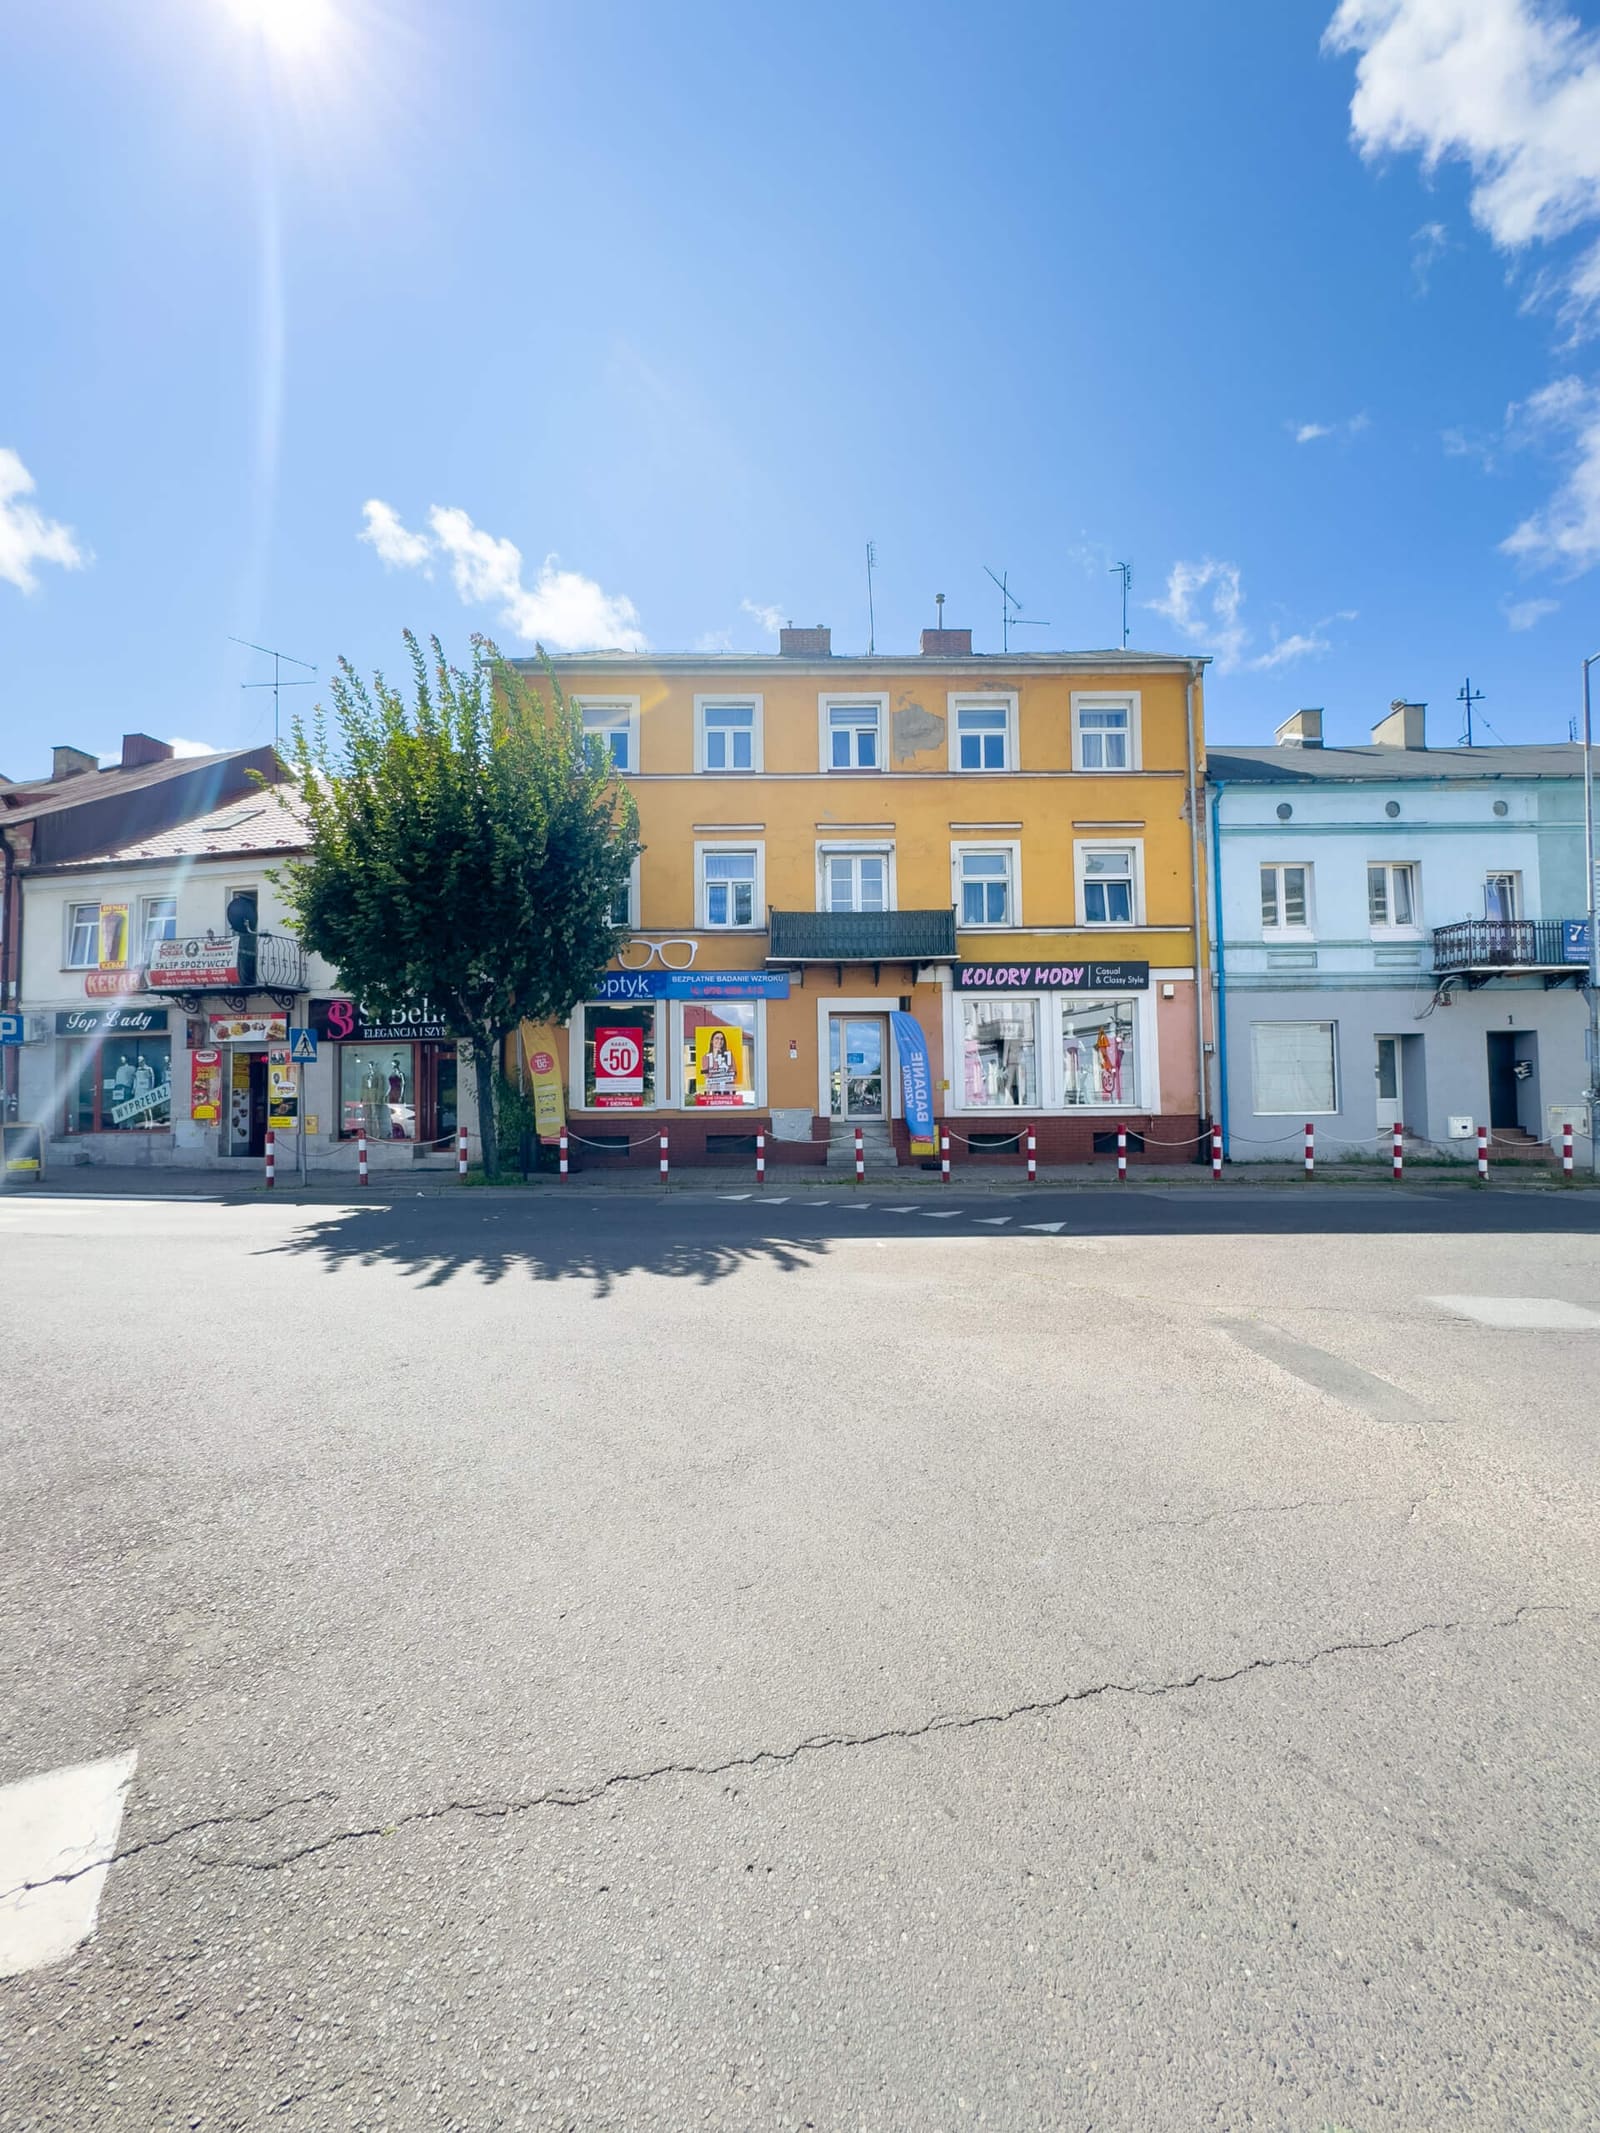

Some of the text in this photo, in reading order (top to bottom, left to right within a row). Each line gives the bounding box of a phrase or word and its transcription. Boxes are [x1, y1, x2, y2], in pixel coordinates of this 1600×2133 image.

[962, 966, 1085, 986] KOLORY MODY
[1095, 967, 1121, 976] Casual
[672, 975, 784, 983] BEZPŁATNE BADANIE WZROKU
[1095, 976, 1145, 985] & Classy Style
[594, 975, 649, 998] optyk
[66, 1009, 153, 1032] Top Lady
[1507, 1014, 1513, 1025] 1
[0, 1018, 17, 1035] P
[363, 1027, 418, 1039] ELEGANCJA
